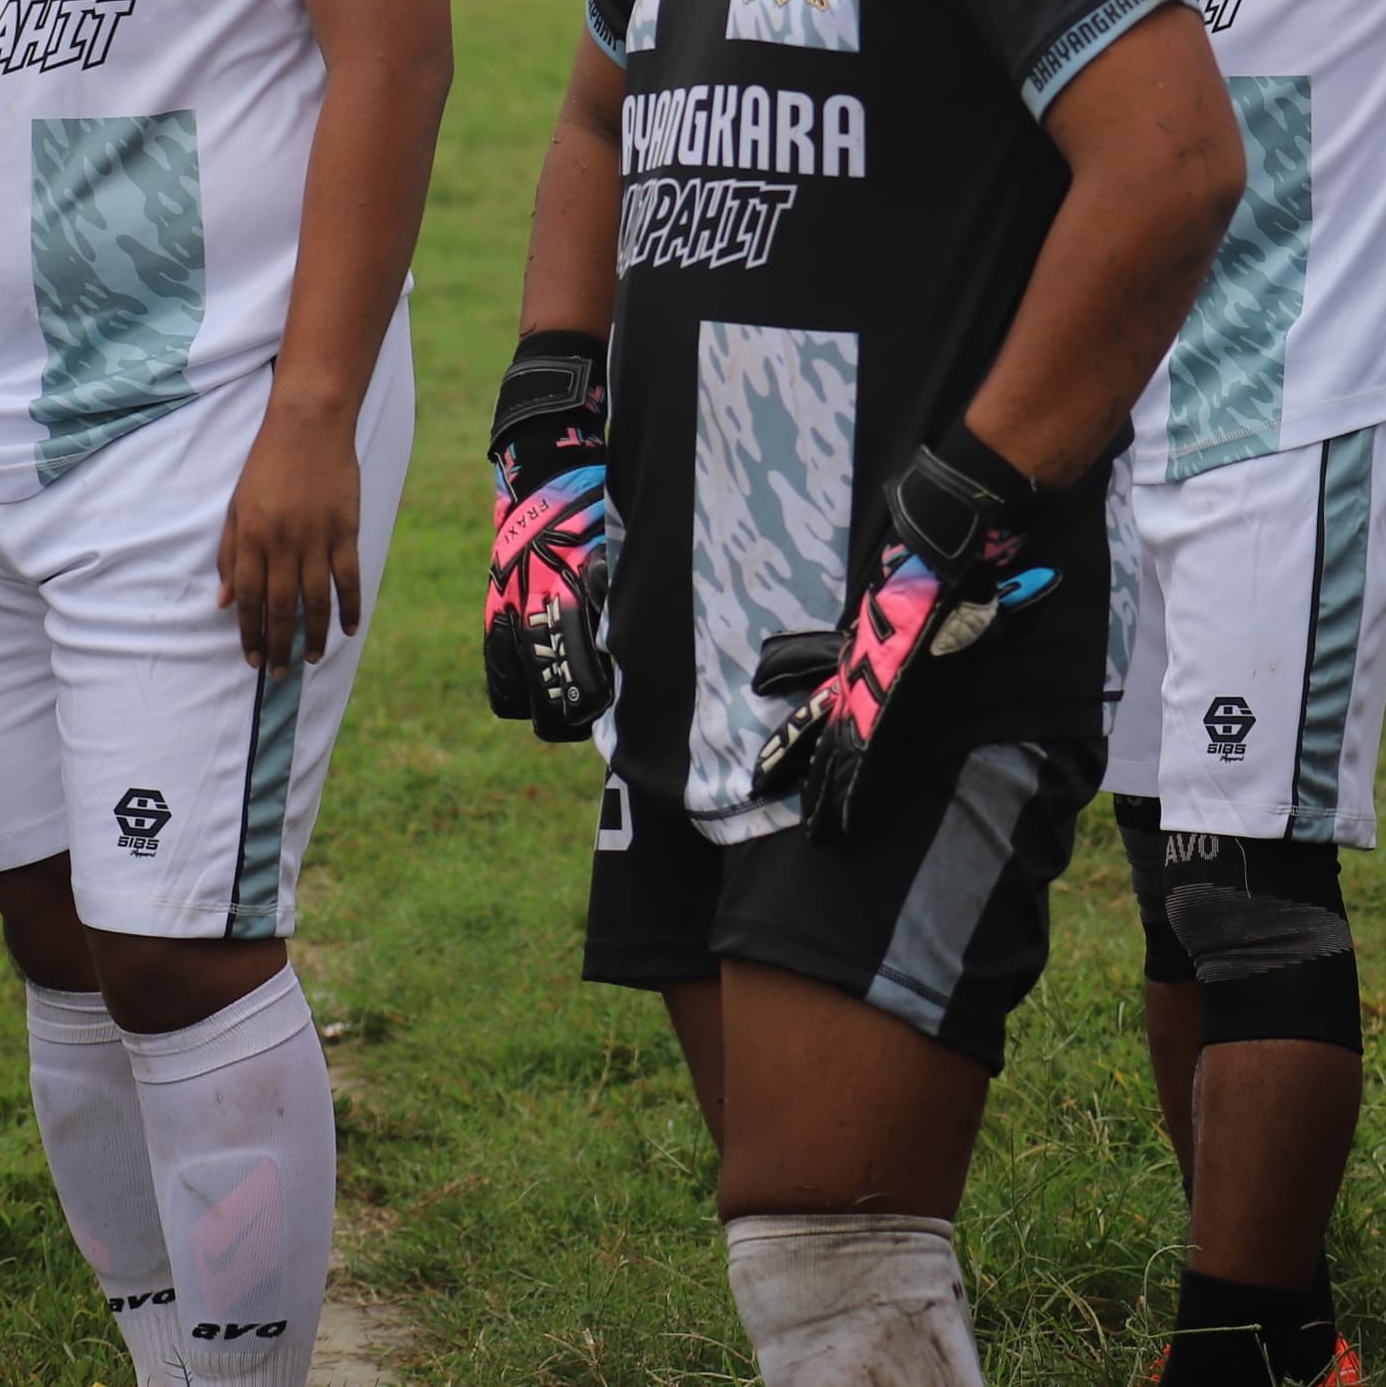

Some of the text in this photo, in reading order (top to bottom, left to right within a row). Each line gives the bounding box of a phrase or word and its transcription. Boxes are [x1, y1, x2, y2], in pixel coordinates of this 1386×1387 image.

[619, 84, 866, 178] AYANGKARA
[1207, 743, 1247, 755] SIBS
[117, 836, 160, 850] SIBS
[1164, 833, 1219, 868] AVO
